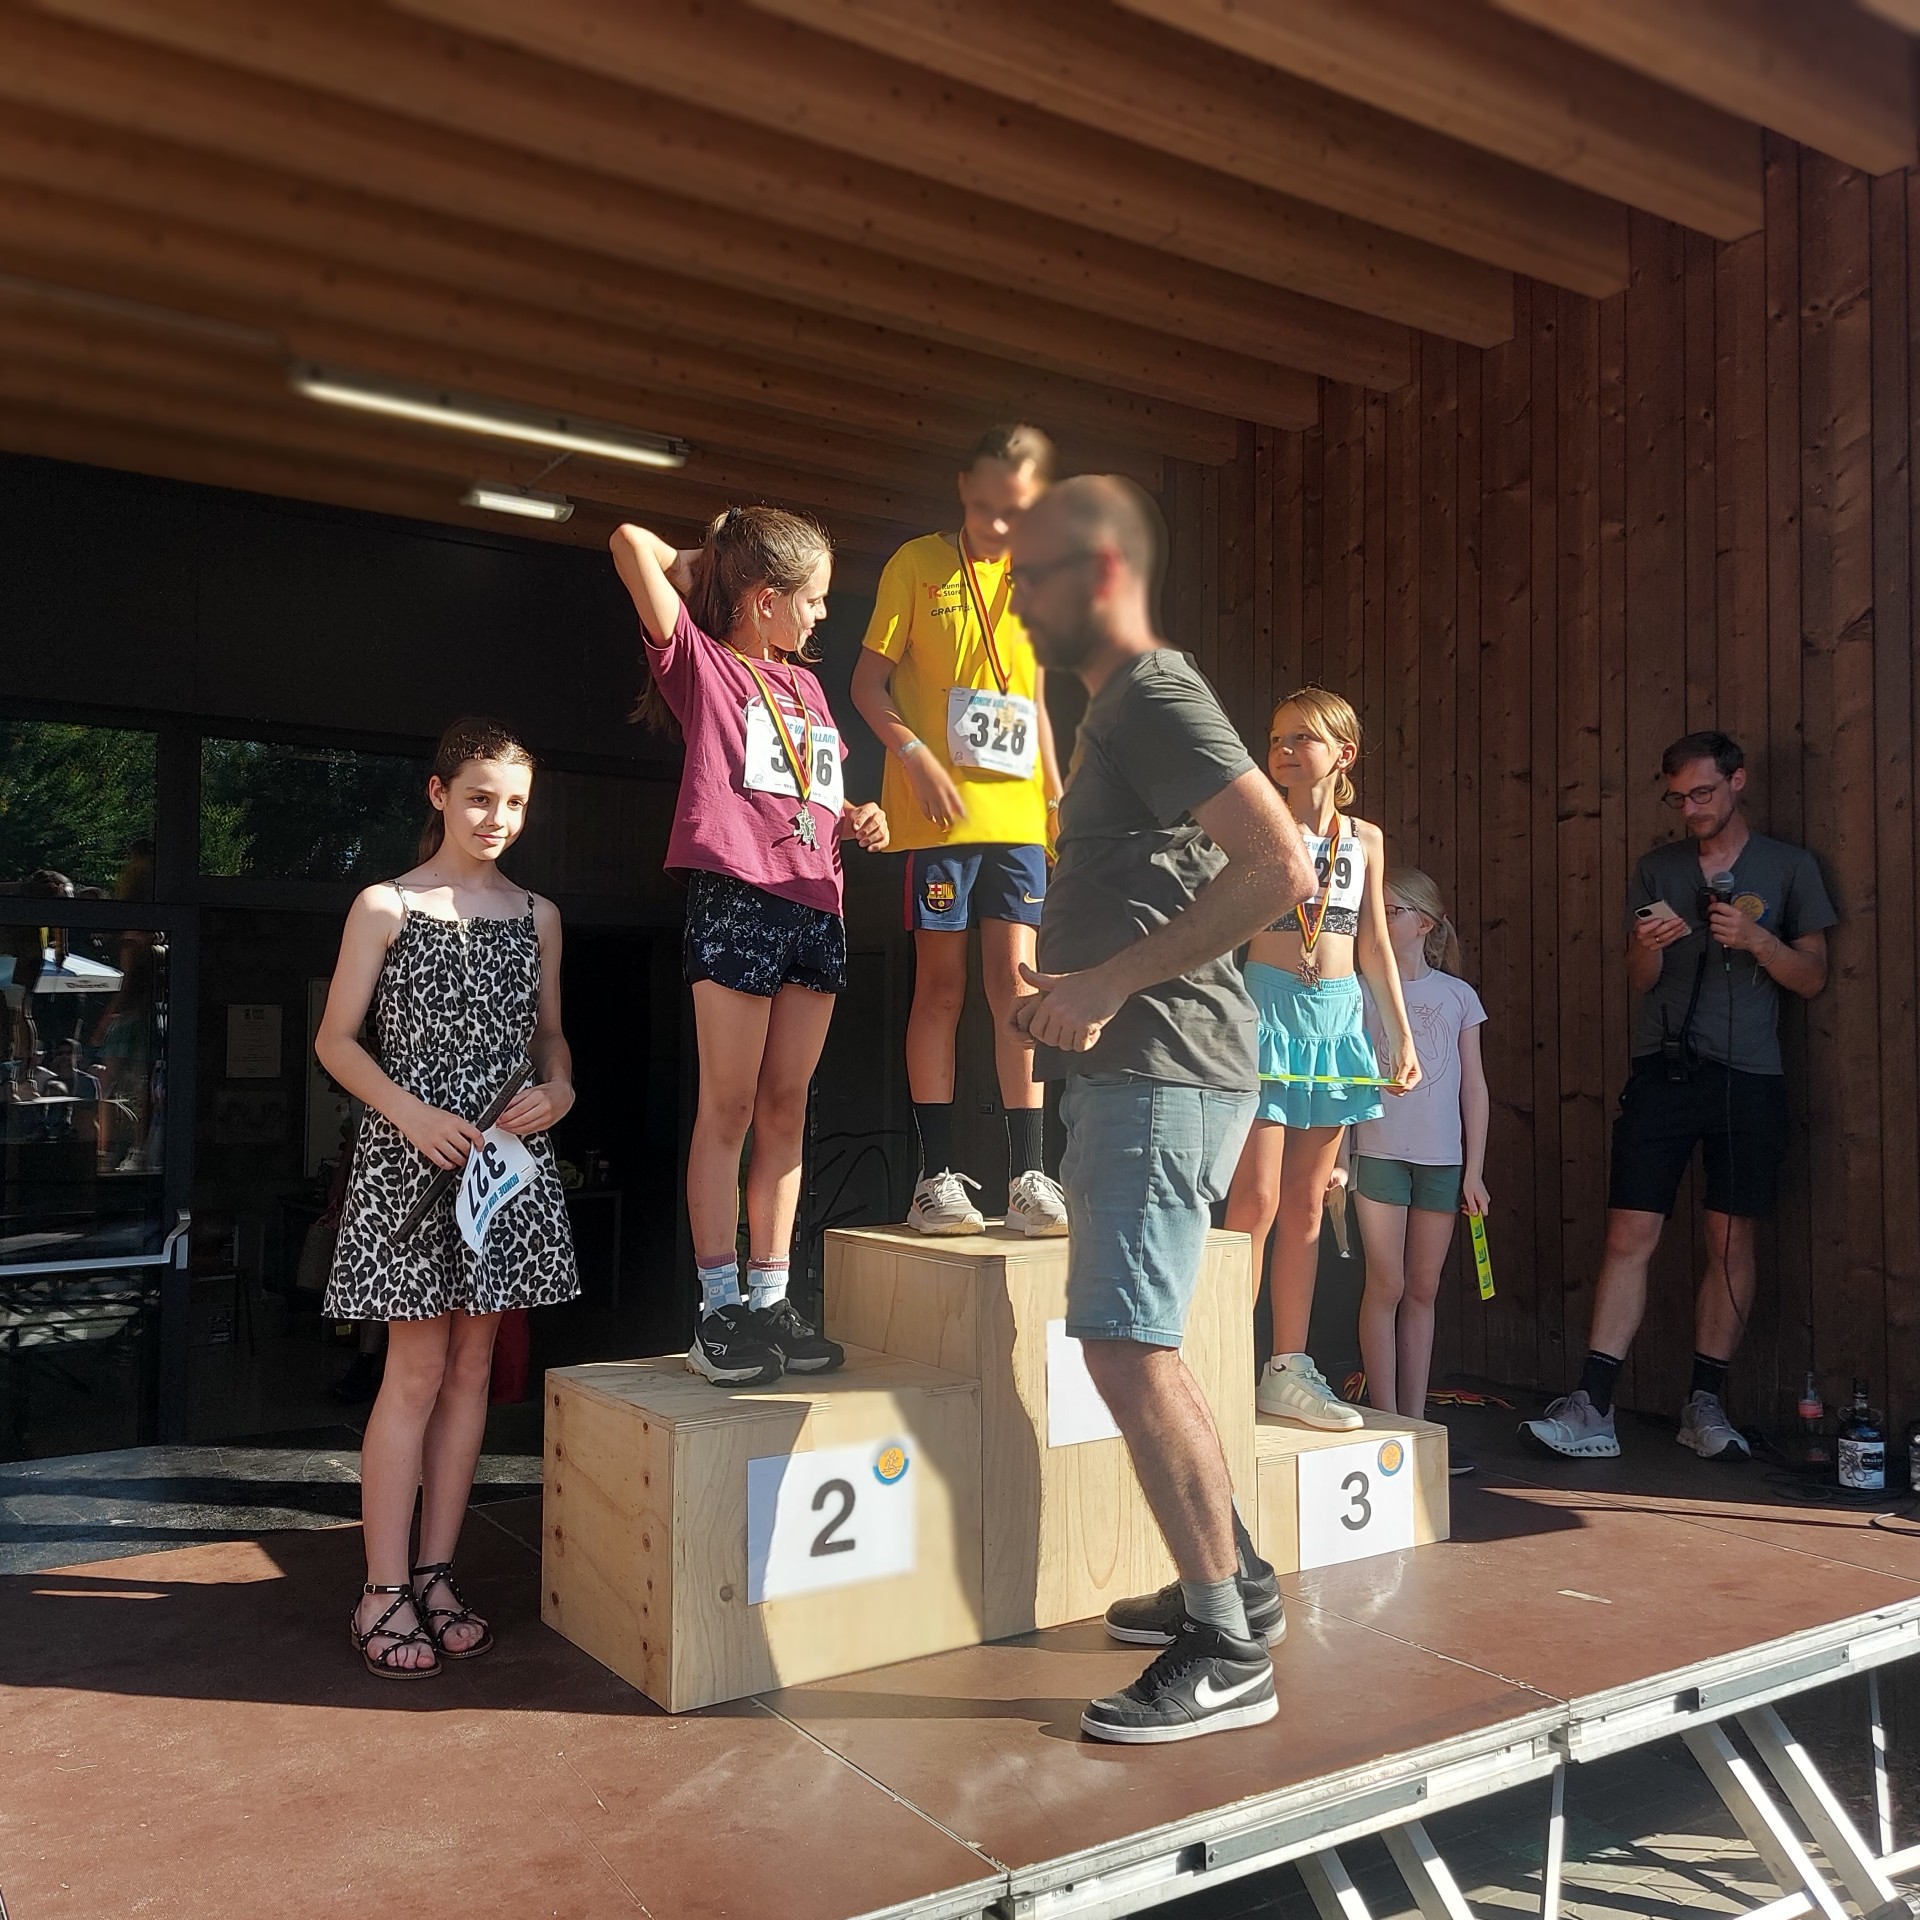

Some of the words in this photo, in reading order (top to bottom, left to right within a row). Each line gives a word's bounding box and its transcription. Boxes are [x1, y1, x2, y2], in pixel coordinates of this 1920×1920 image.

[930, 605, 963, 617] CRAFT
[969, 712, 1026, 756] 328
[1314, 856, 1352, 889] 29
[467, 1141, 506, 1221] 327
[498, 1173, 520, 1198] RONDE
[810, 1478, 856, 1557] 2
[1340, 1471, 1372, 1531] 3
